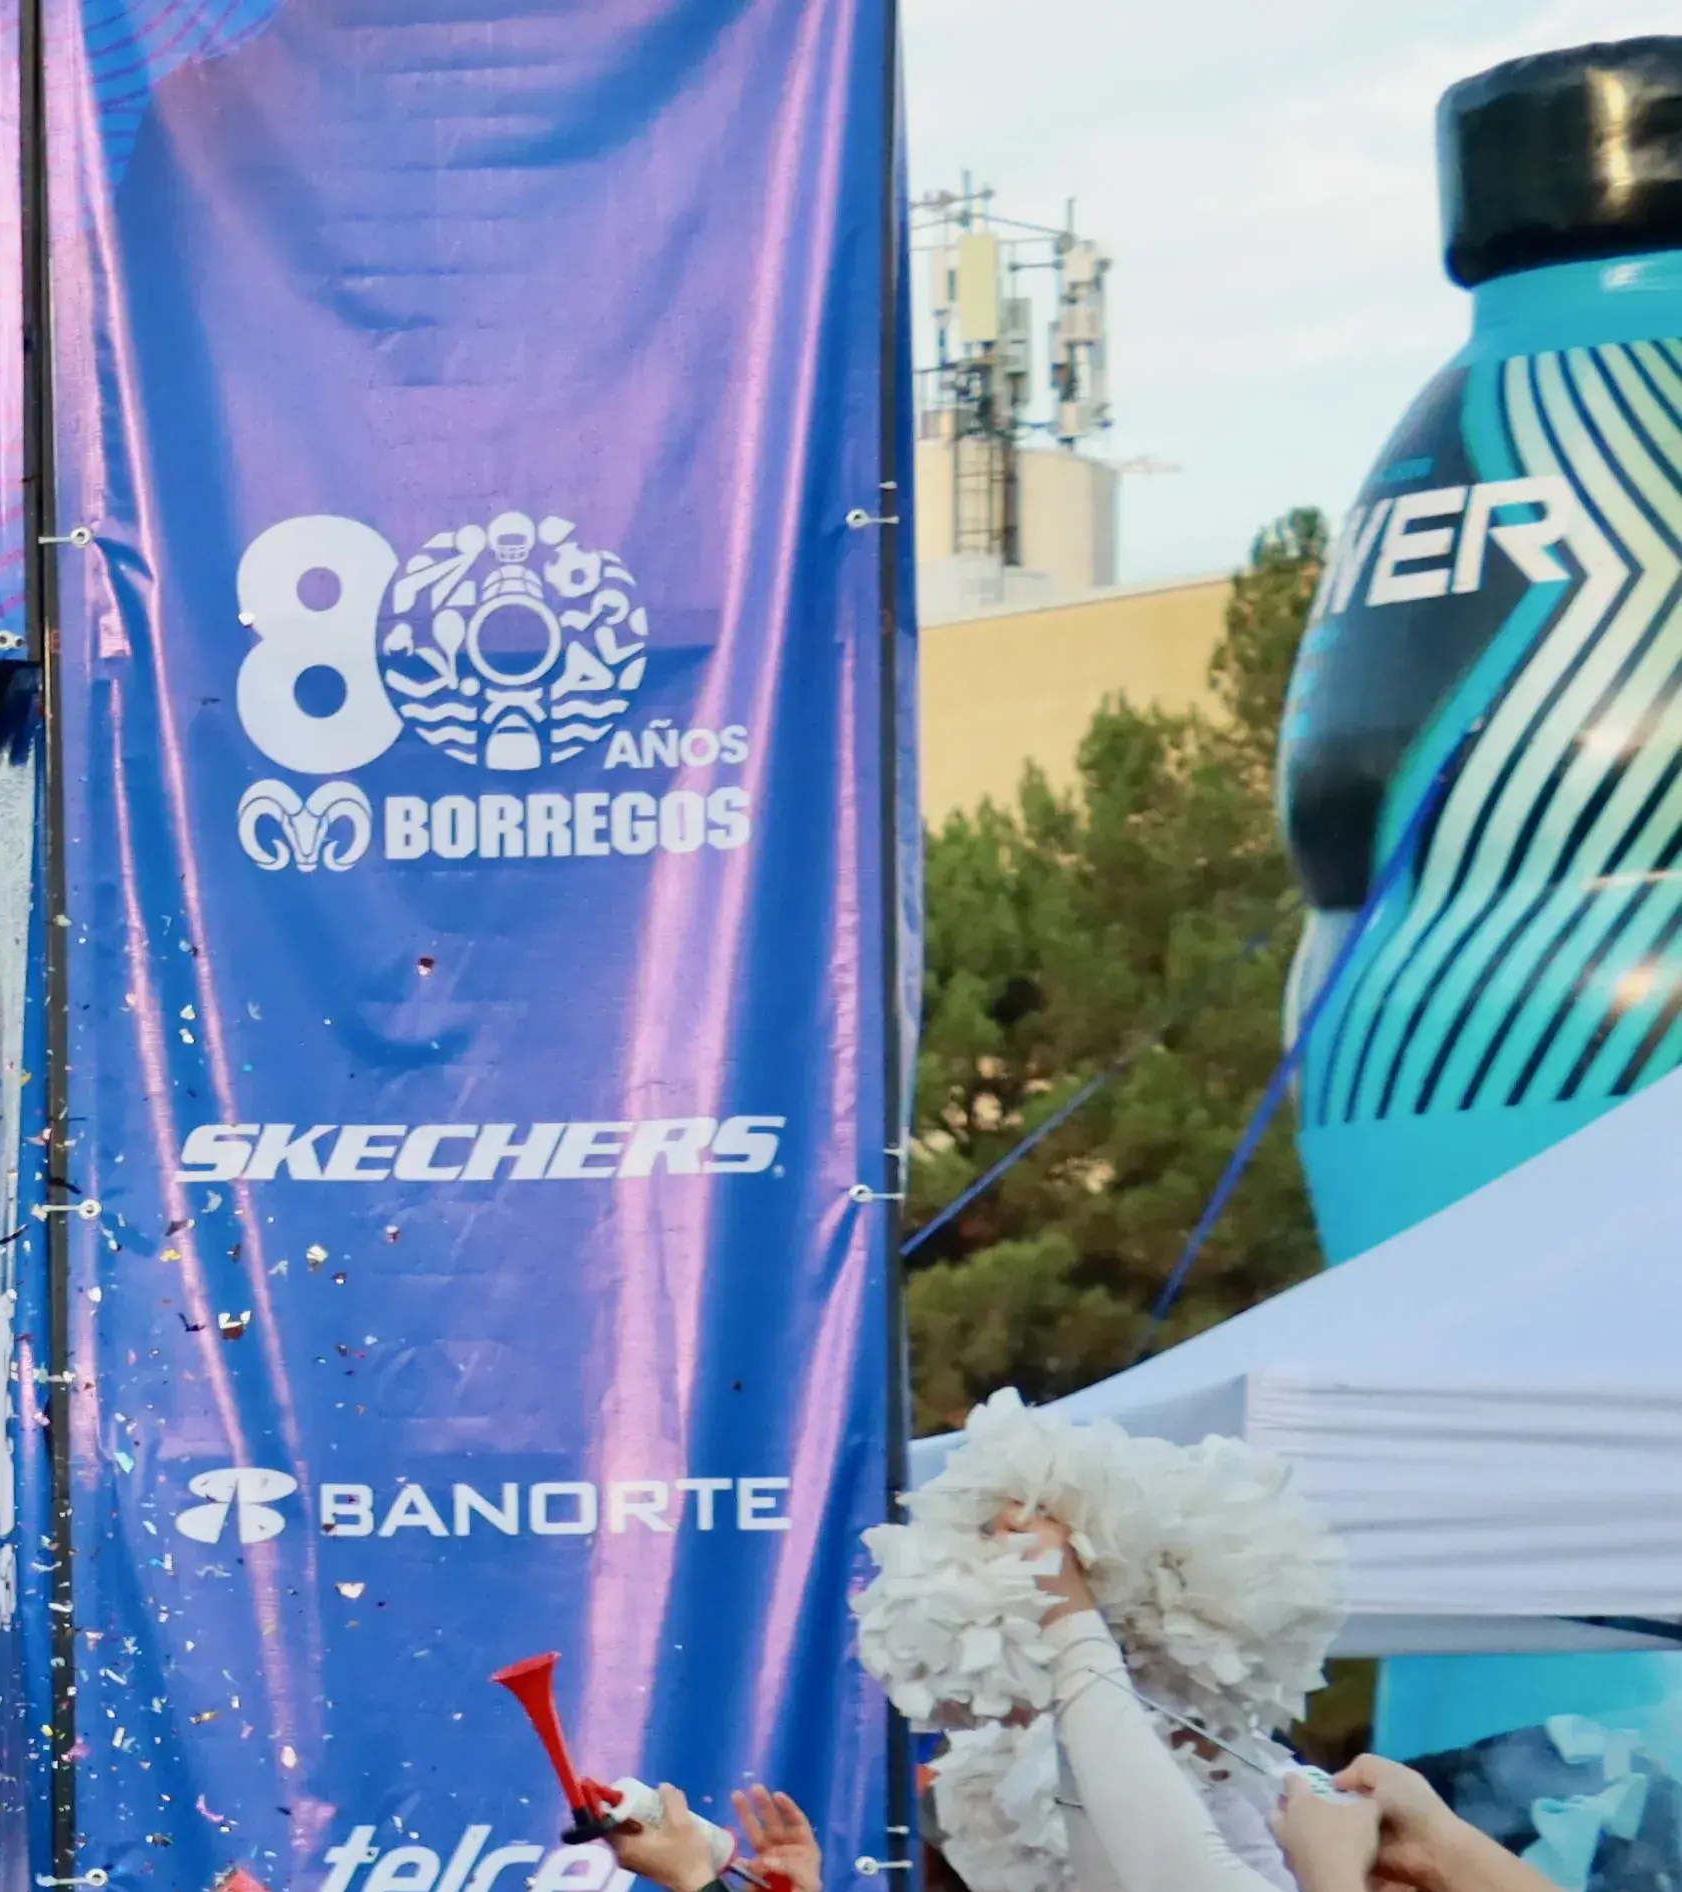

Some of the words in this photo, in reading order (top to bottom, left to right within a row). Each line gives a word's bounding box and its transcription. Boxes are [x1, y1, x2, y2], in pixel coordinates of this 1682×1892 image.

[1309, 476, 1576, 622] WER
[604, 719, 749, 770] AÑOS
[385, 786, 751, 861] BORREGOS
[175, 1115, 787, 1182] SKECHERS
[319, 1476, 793, 1538] BANORTE
